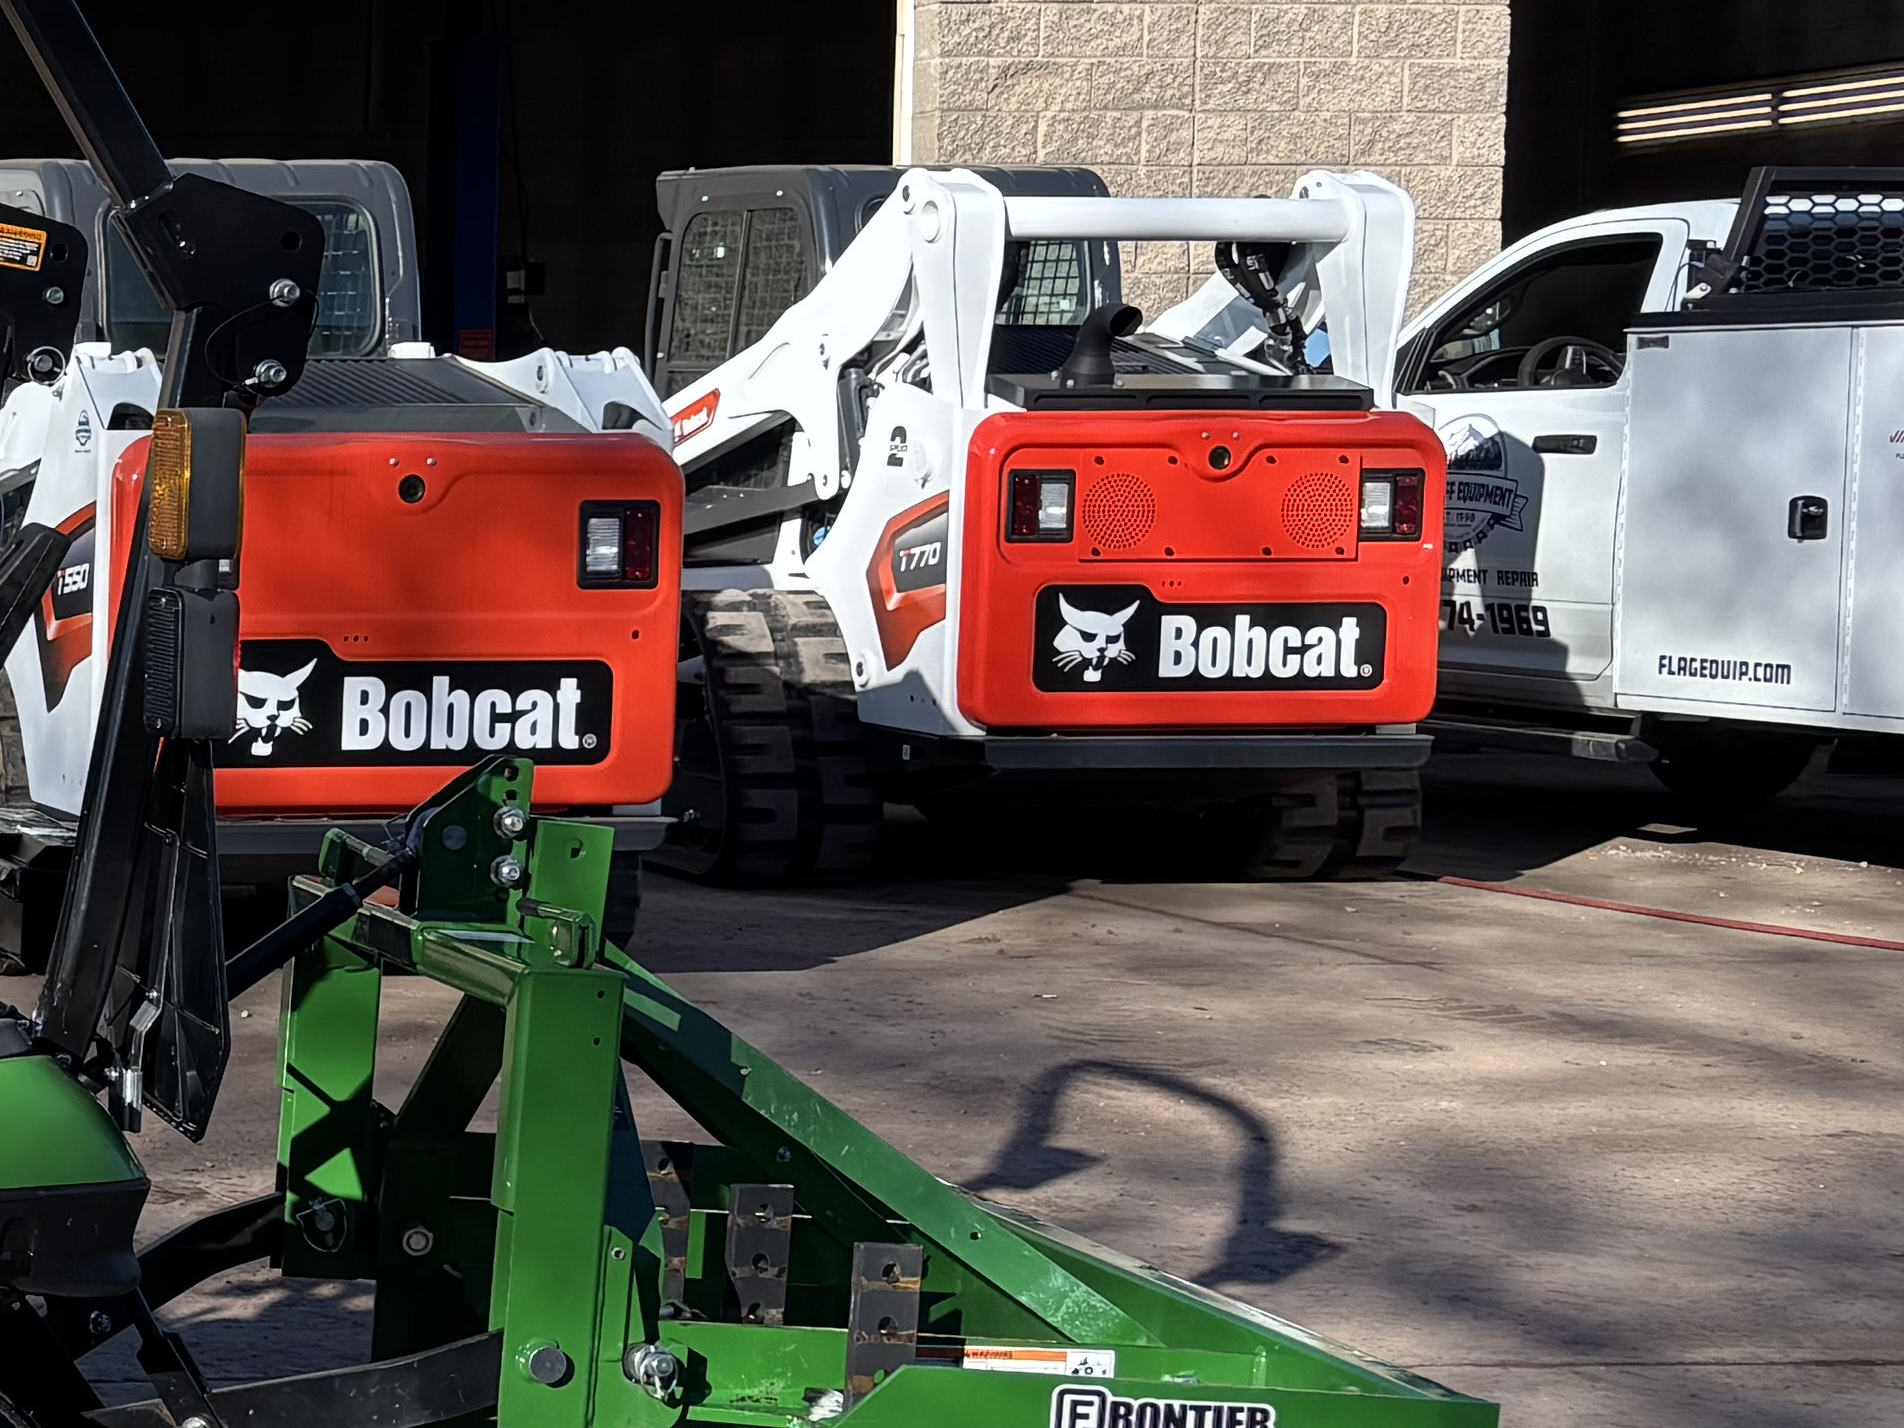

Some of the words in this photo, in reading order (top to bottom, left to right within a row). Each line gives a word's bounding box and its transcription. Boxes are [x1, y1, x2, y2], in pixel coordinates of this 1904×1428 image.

[1457, 482, 1515, 509] EQUIPMENT
[899, 541, 942, 572] T770
[1496, 571, 1540, 588] REPAIR
[1157, 614, 1361, 680] Bobcat
[1657, 654, 1792, 685] FLAGEQUIP.COM
[340, 675, 582, 752] Bobcat
